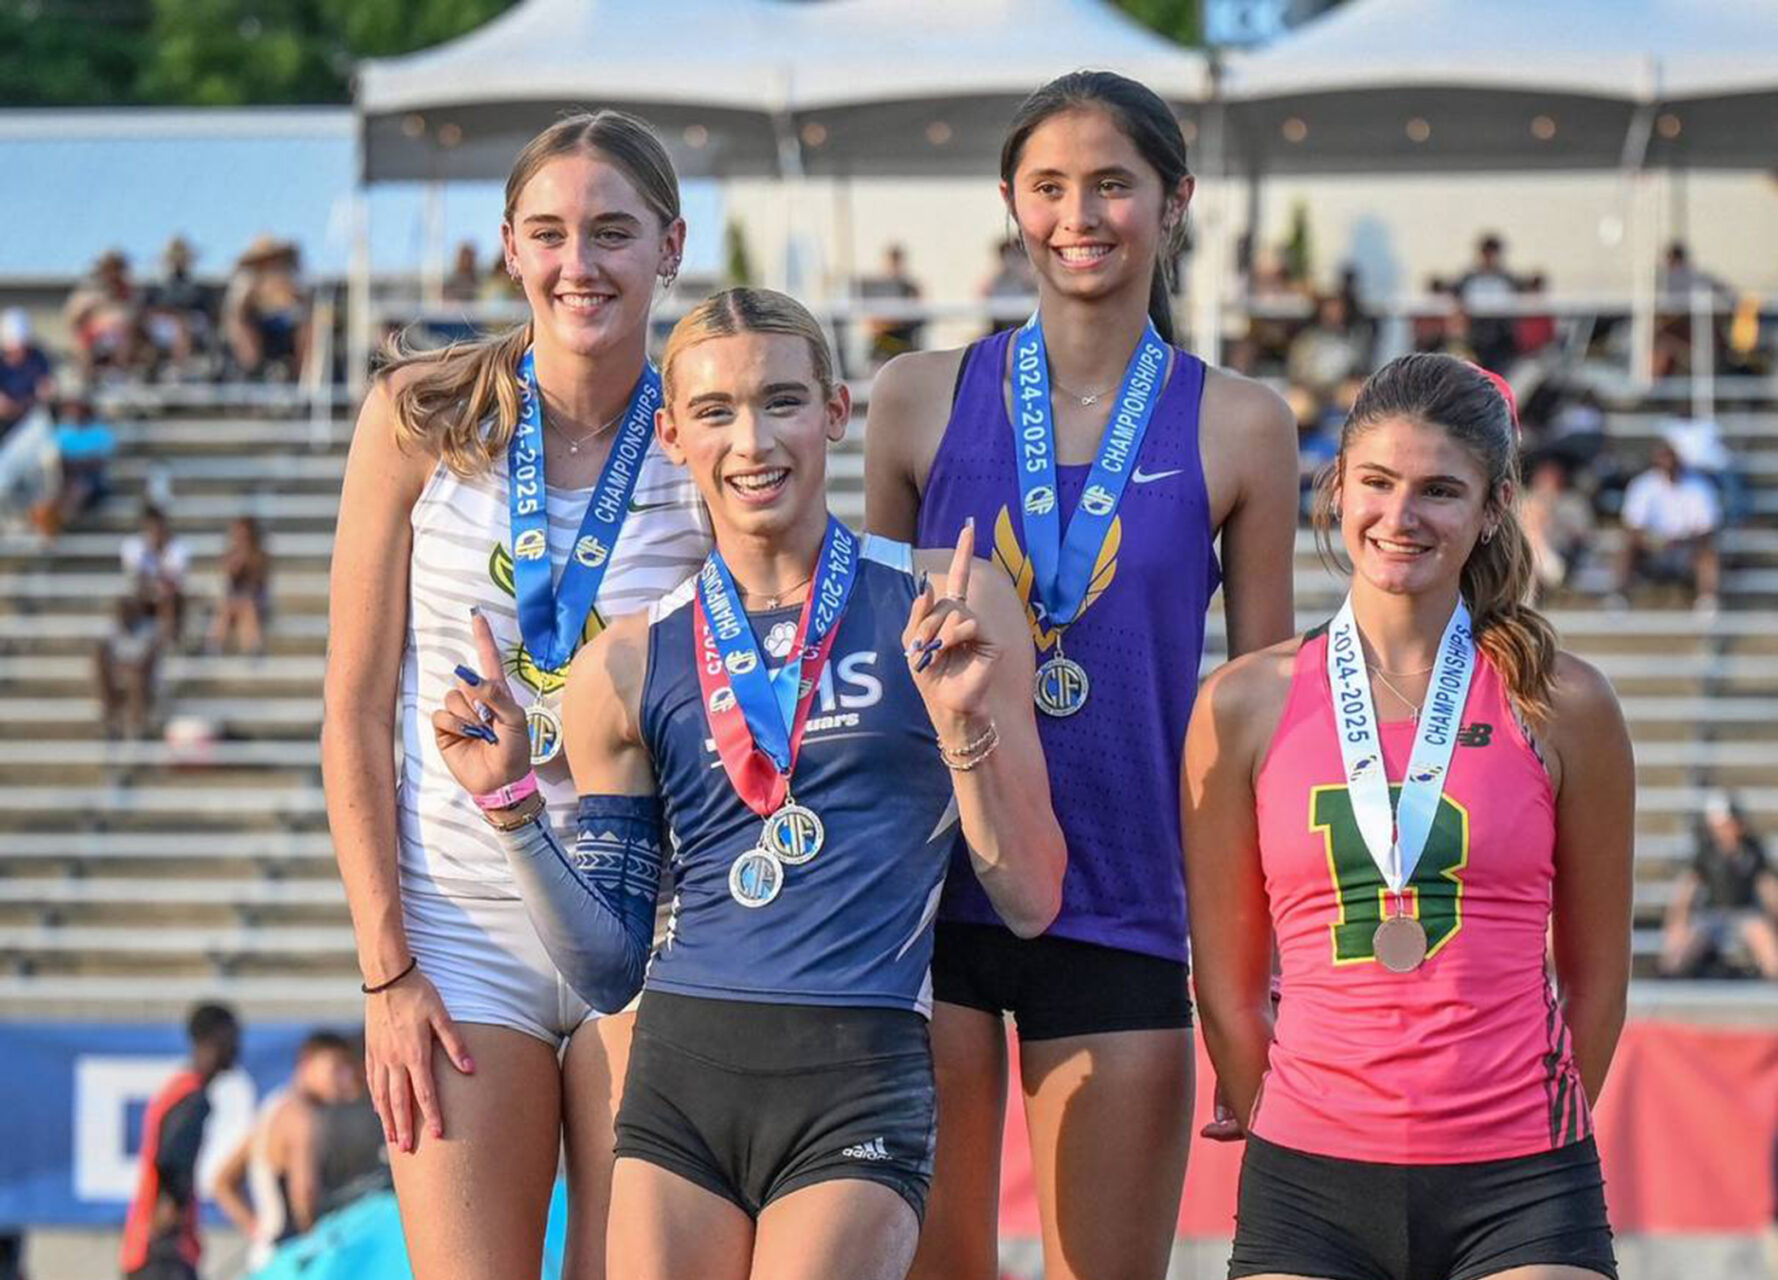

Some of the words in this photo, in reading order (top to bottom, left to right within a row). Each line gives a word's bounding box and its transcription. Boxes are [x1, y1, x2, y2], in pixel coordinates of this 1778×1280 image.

[594, 384, 658, 523] CHAMPIONSHIPS
[1019, 342, 1048, 473] 2024-2025
[1101, 343, 1163, 473] CHAMPIONSHIPS
[815, 527, 853, 637] 2024-2025
[1334, 623, 1370, 743] 2024-2025
[1424, 624, 1472, 746] CHAMPIONSHIPS
[1309, 782, 1471, 966] B
